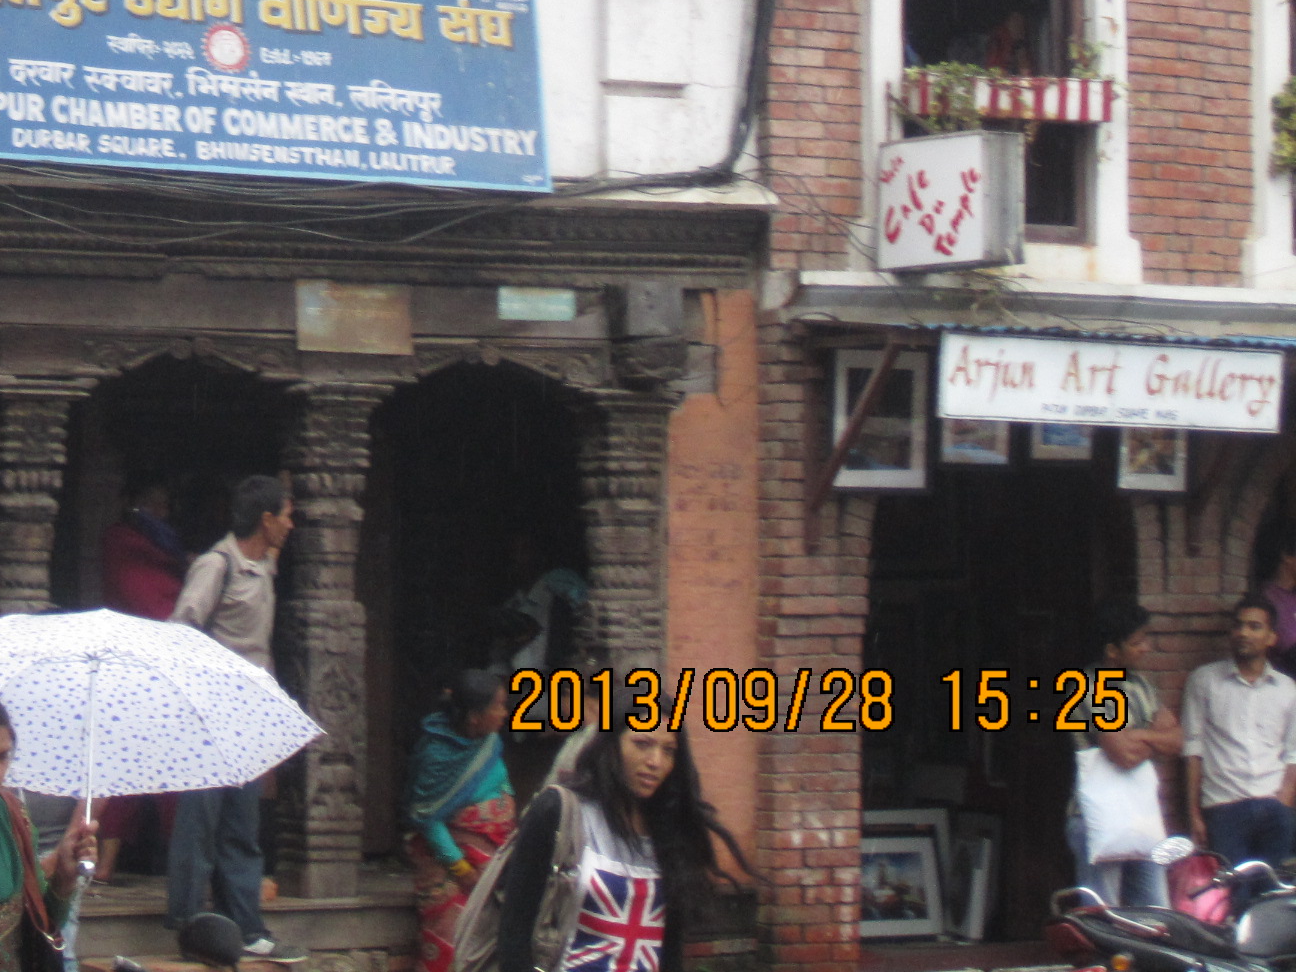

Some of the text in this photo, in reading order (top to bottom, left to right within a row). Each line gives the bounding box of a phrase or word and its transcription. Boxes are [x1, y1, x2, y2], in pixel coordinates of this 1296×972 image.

[51, 95, 183, 132] CHAMBER
[184, 105, 217, 134] OF
[222, 107, 371, 145] COMMERCE
[375, 118, 400, 146] &
[403, 121, 538, 157] INDUSTRY
[346, 78, 444, 123] ललितपुर
[12, 127, 93, 154] DURBAR
[369, 151, 457, 176] LALITPUR
[948, 344, 1277, 418] Arjun Art Gallery
